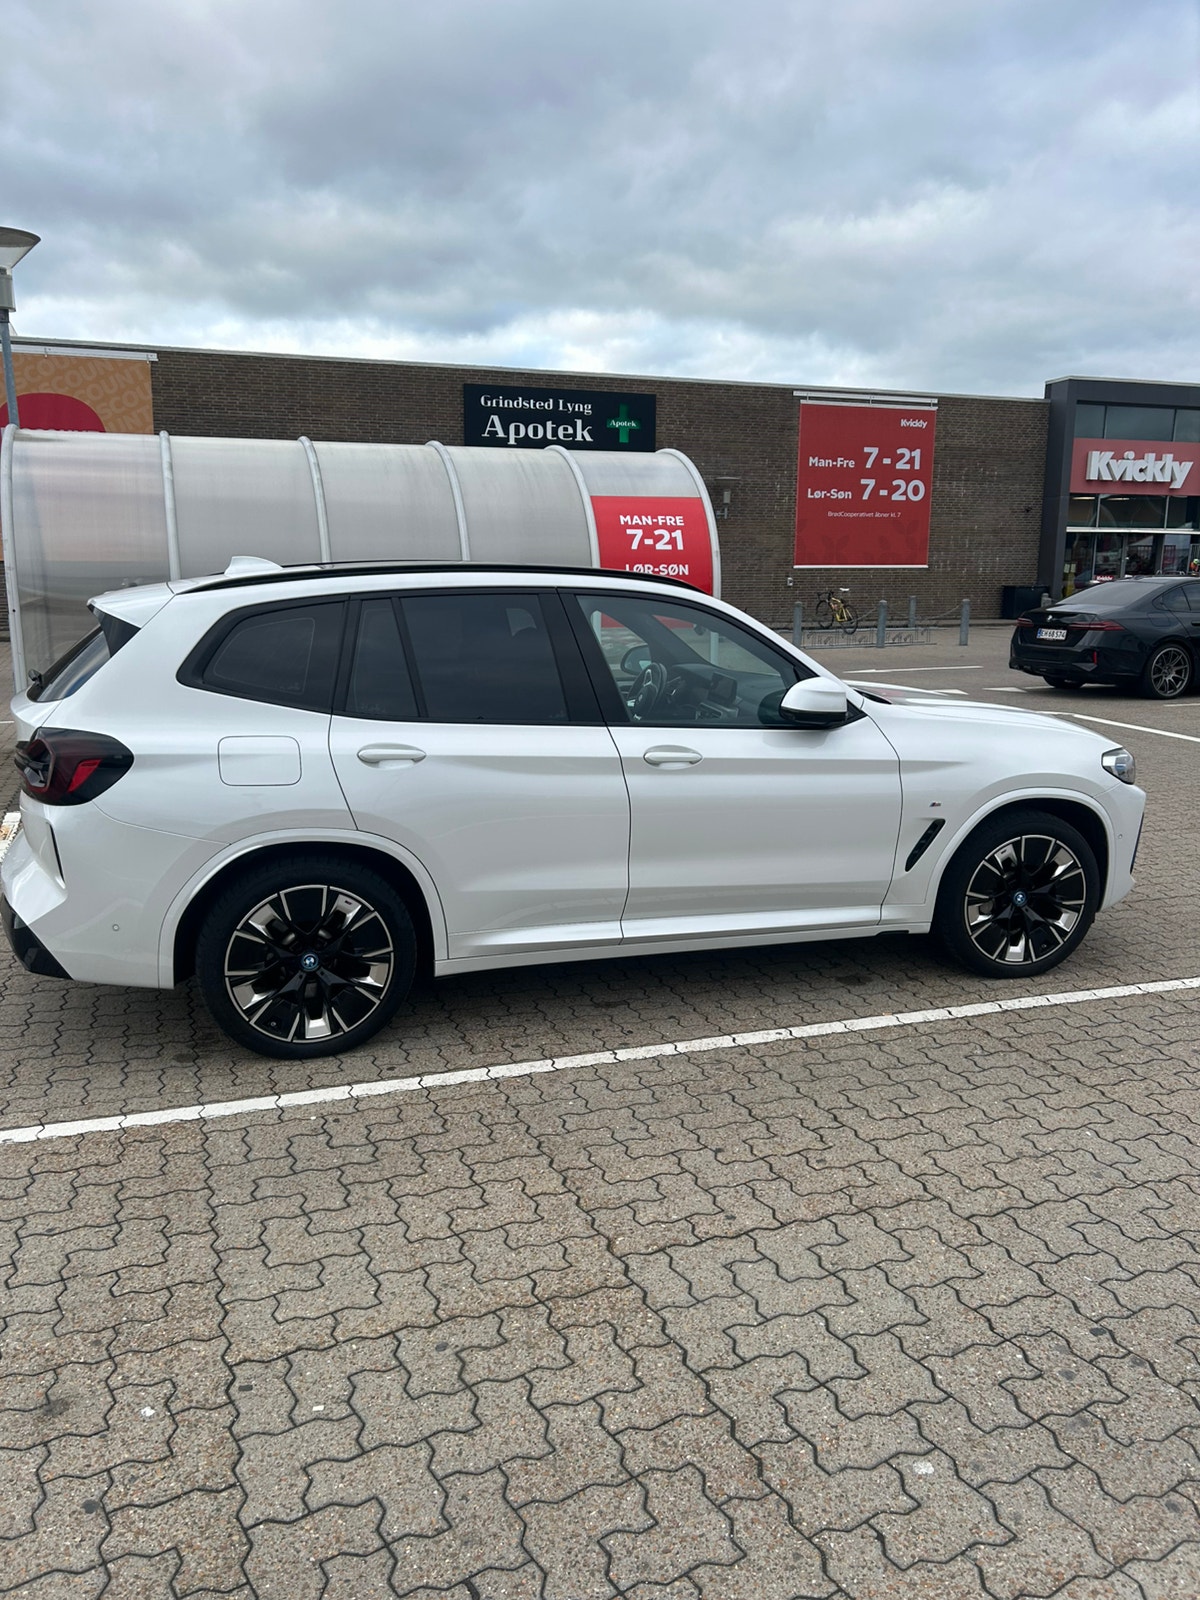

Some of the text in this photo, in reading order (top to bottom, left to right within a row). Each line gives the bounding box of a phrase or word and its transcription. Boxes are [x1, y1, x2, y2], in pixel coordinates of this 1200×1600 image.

[480, 394, 592, 415] Grindsted Lyng
[481, 414, 594, 445] Apotek
[609, 419, 637, 428] Apotek
[808, 456, 855, 468] Man-Fre
[1086, 450, 1193, 489] Kvickly
[807, 488, 852, 499] Lør-Søn
[619, 514, 685, 526] MAN-FRE
[626, 529, 684, 551] 7-21
